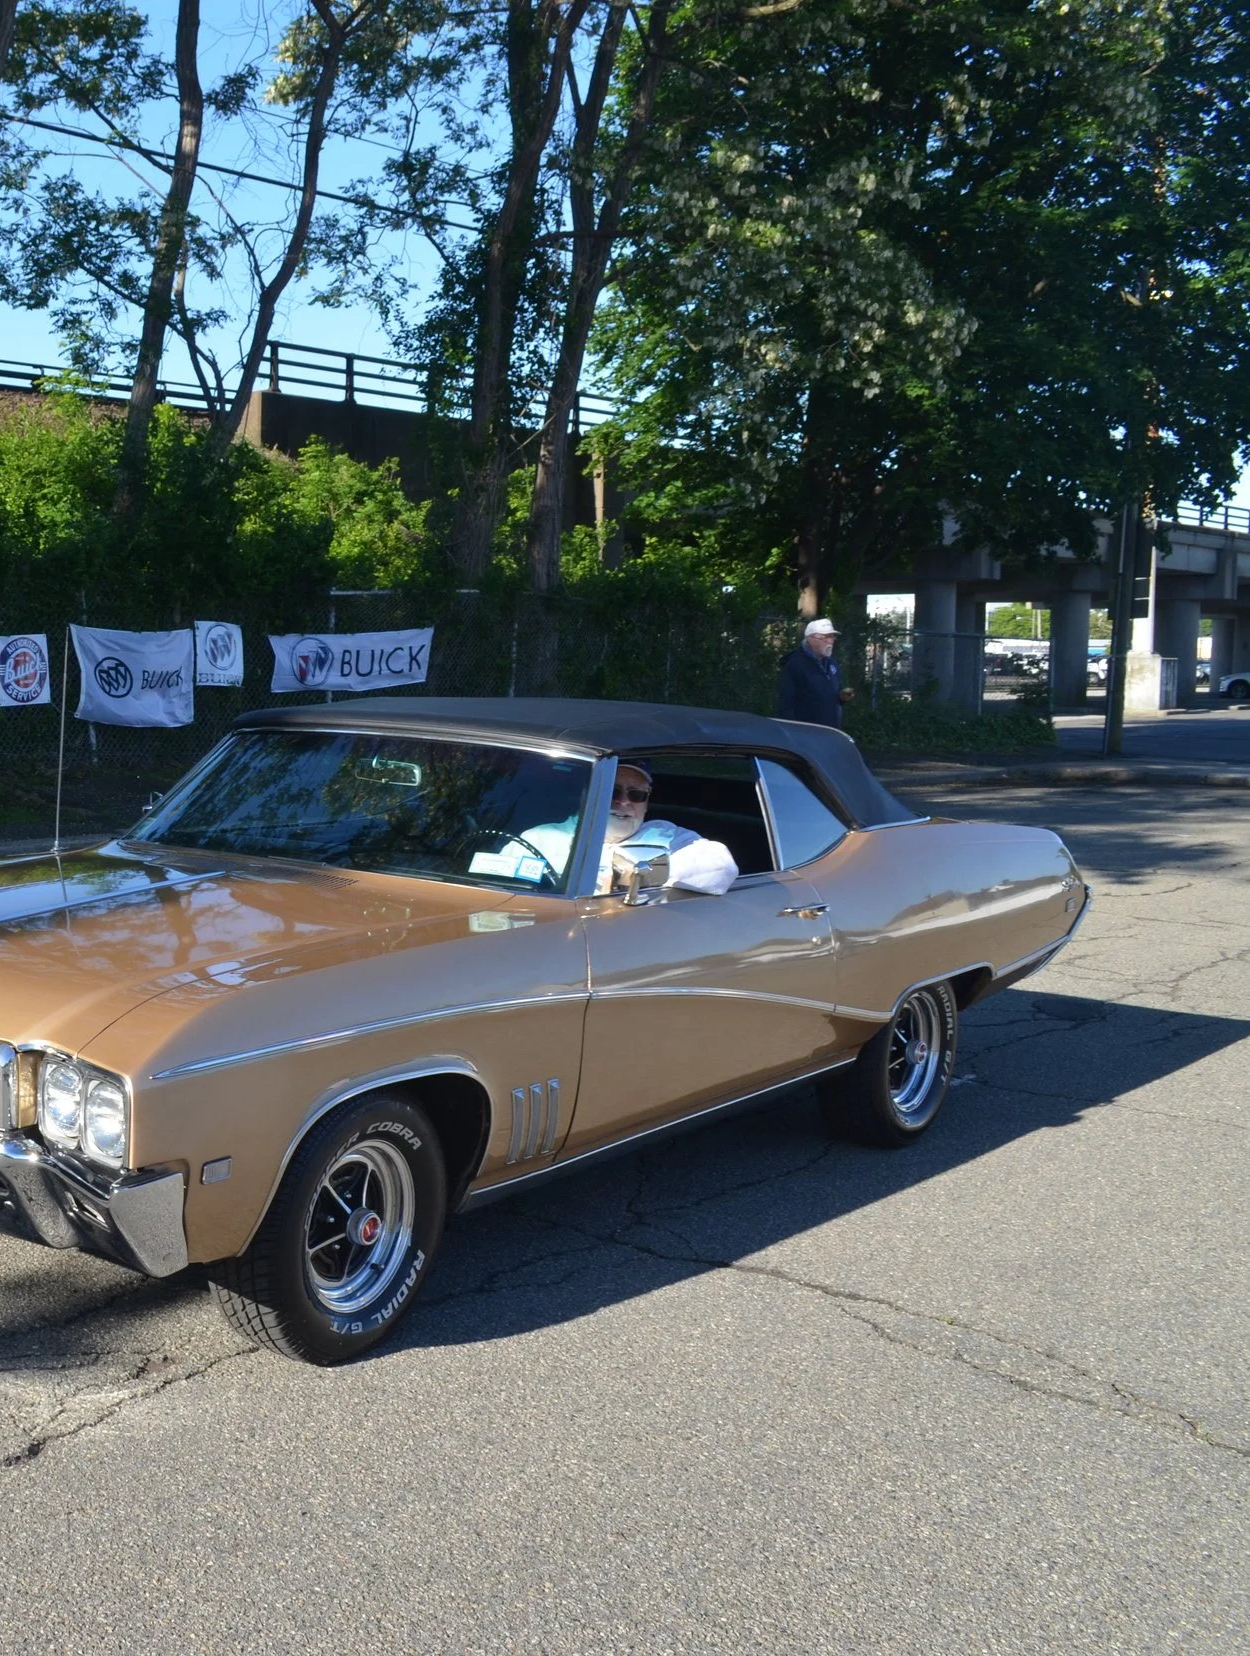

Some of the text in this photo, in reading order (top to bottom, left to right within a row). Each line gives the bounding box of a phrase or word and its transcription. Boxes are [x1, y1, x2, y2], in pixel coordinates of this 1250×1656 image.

[340, 644, 425, 678] BUICK
[6, 684, 41, 701] SERVICE
[141, 666, 183, 690] BUICK
[937, 986, 953, 1040] RADIAL
[366, 1121, 423, 1151] COBRA
[330, 1250, 425, 1335] RADIAL G/T
